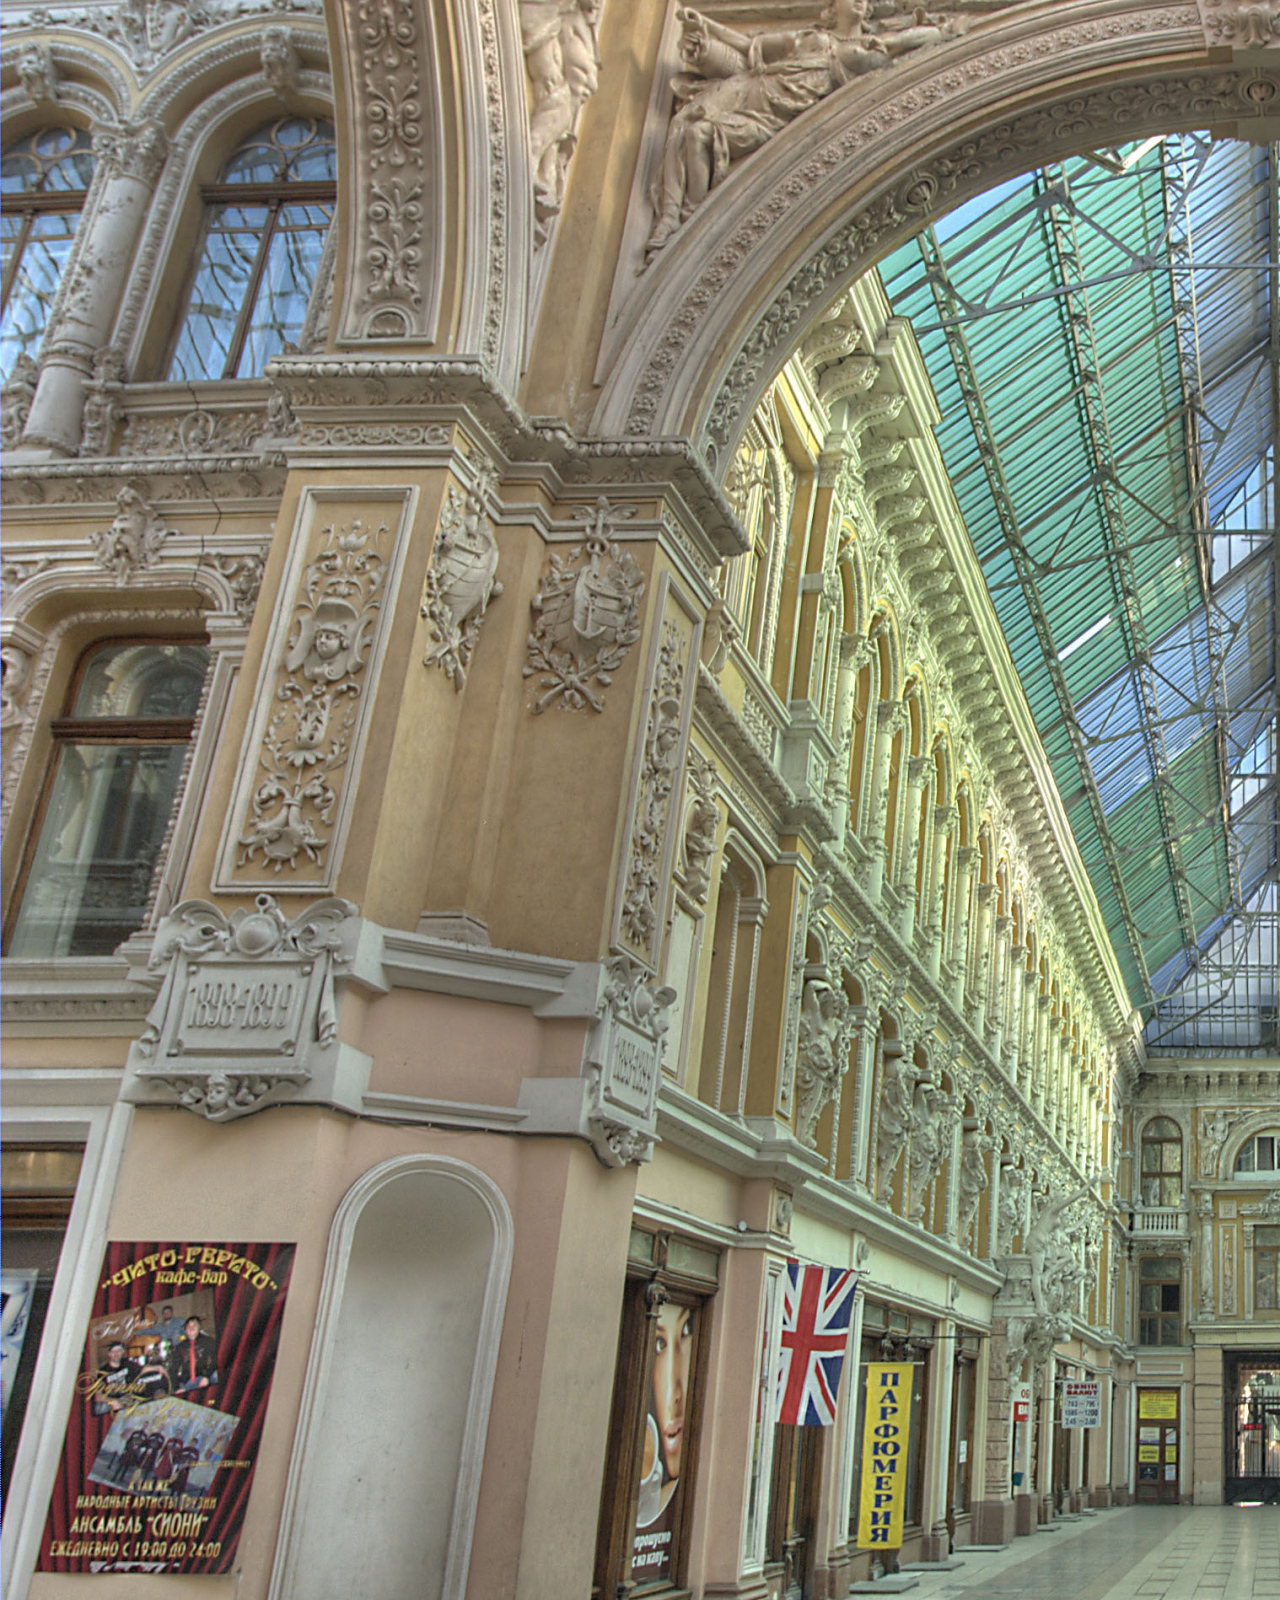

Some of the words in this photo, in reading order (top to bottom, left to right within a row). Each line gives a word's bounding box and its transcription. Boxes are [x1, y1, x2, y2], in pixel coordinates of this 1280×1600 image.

[187, 982, 297, 1029] 1898-1899
[869, 1372, 900, 1542] ПАРФЮМЕРИЯ
[76, 1495, 131, 1509] НАРОДНЫЕ
[132, 1495, 179, 1510] АРТИСТЫ
[70, 1515, 142, 1533] АНСАМБЛЬ
[50, 1541, 119, 1557] ЕЖЕДНЕВНО
[122, 1542, 129, 1557] С
[134, 1542, 165, 1557] 19:00
[168, 1542, 186, 1558] ДО
[189, 1542, 222, 1558] 24:00
